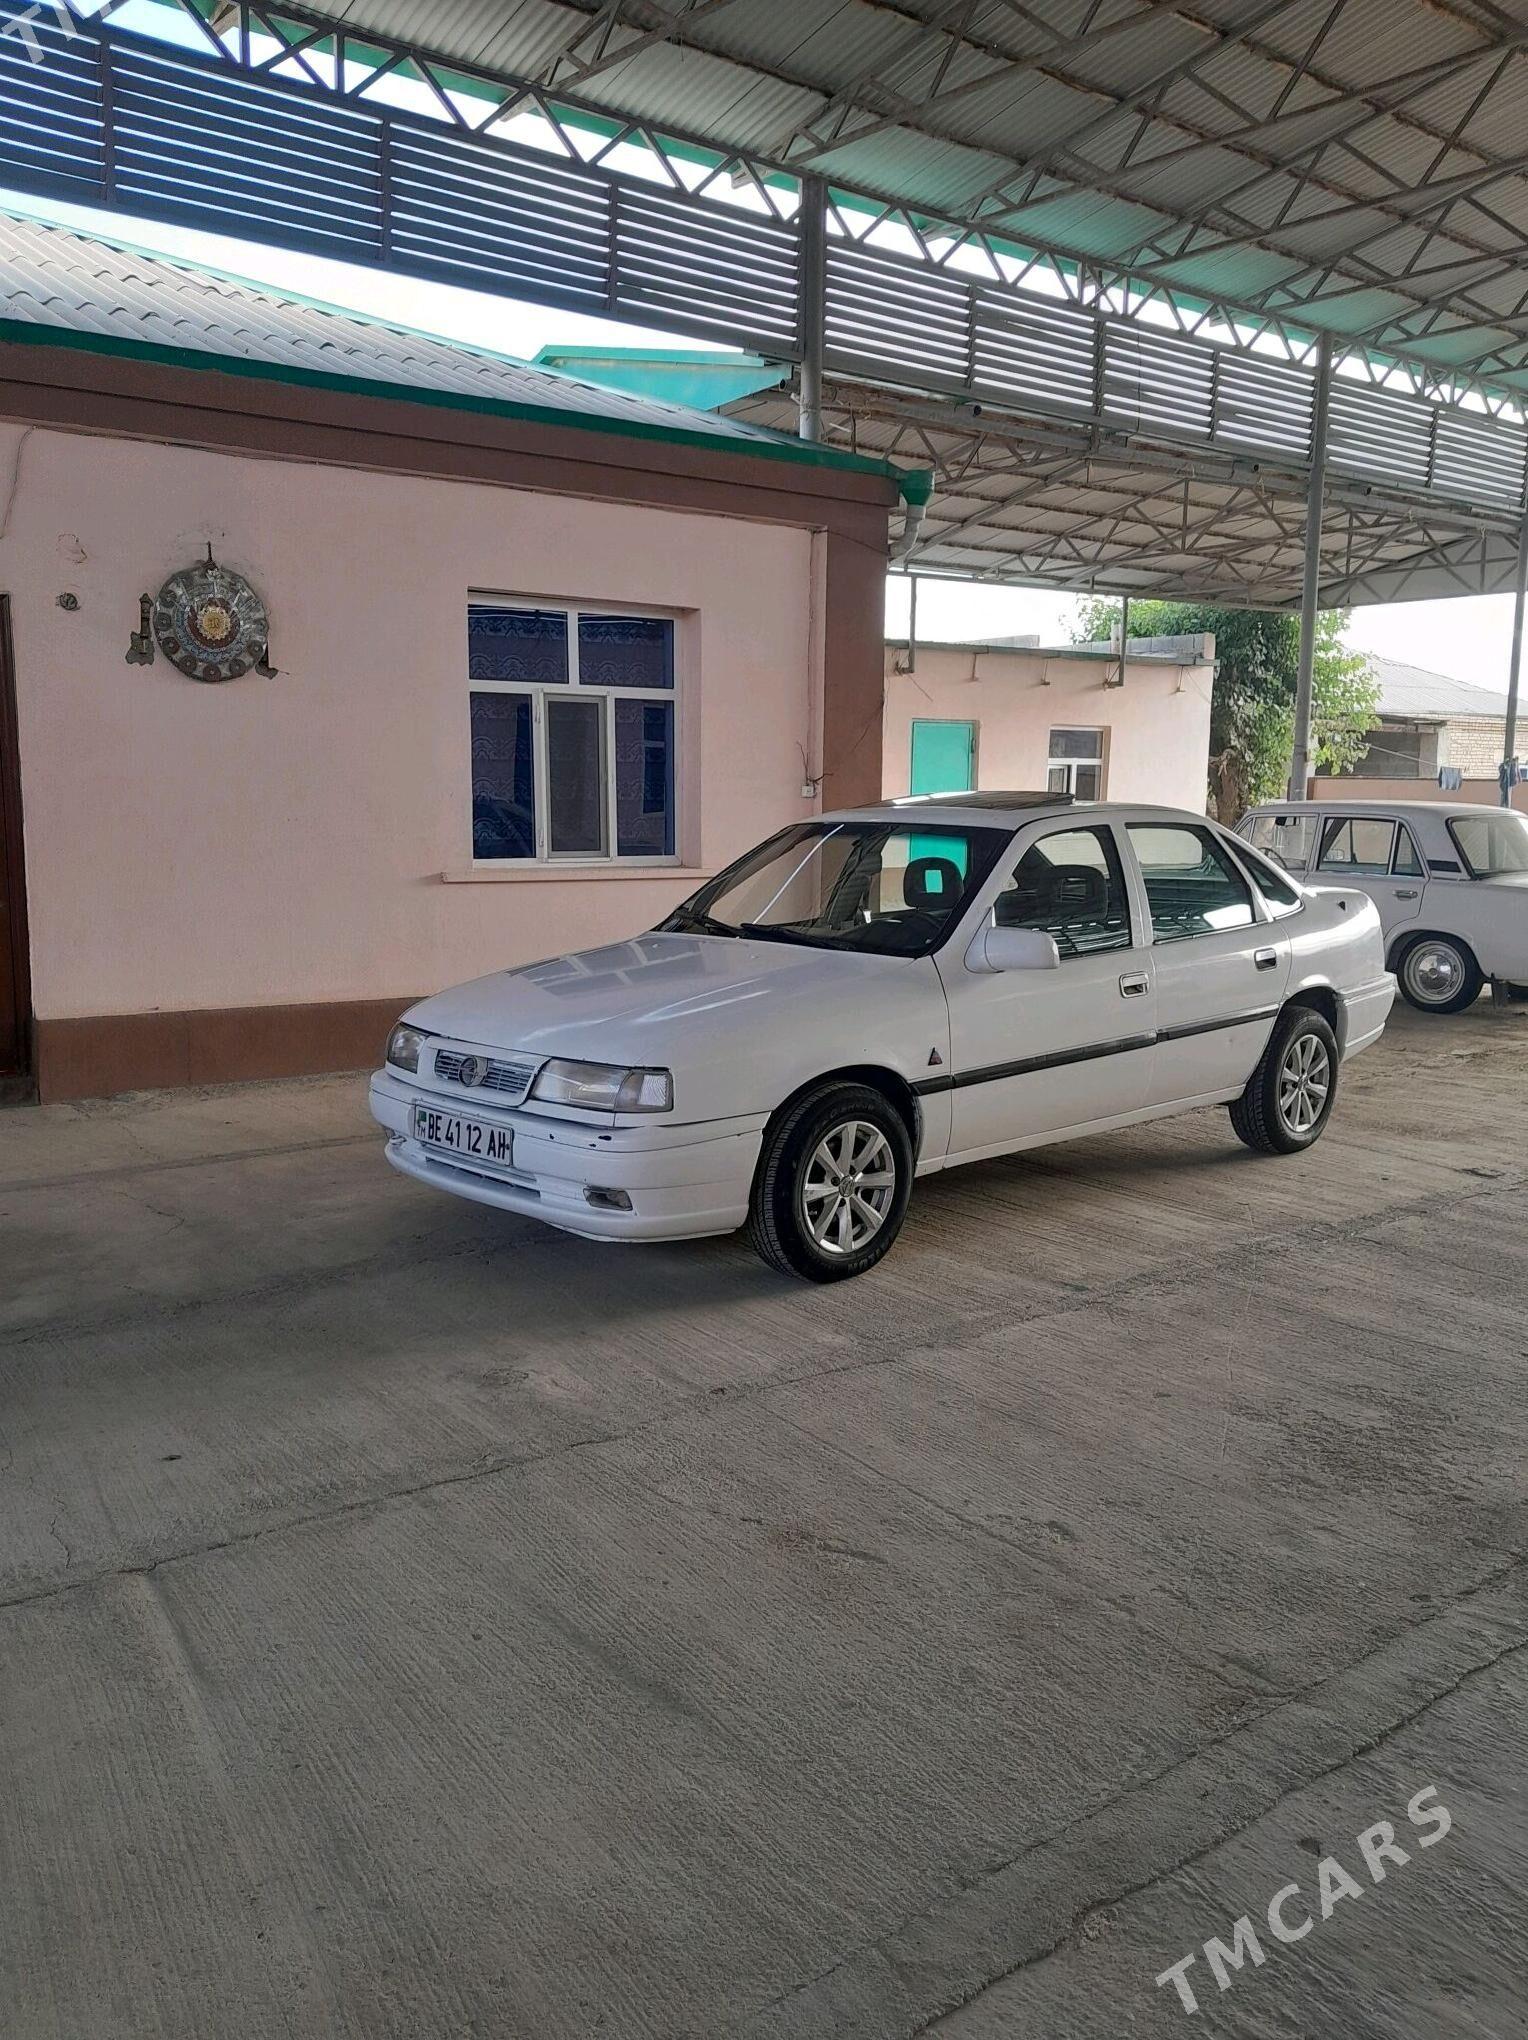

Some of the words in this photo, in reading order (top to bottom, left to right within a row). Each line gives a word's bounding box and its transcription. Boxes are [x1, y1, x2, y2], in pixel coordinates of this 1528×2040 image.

[428, 1112, 442, 1142] BE
[445, 1118, 460, 1148] 41
[466, 1123, 482, 1153] 12
[487, 1129, 506, 1160] AH
